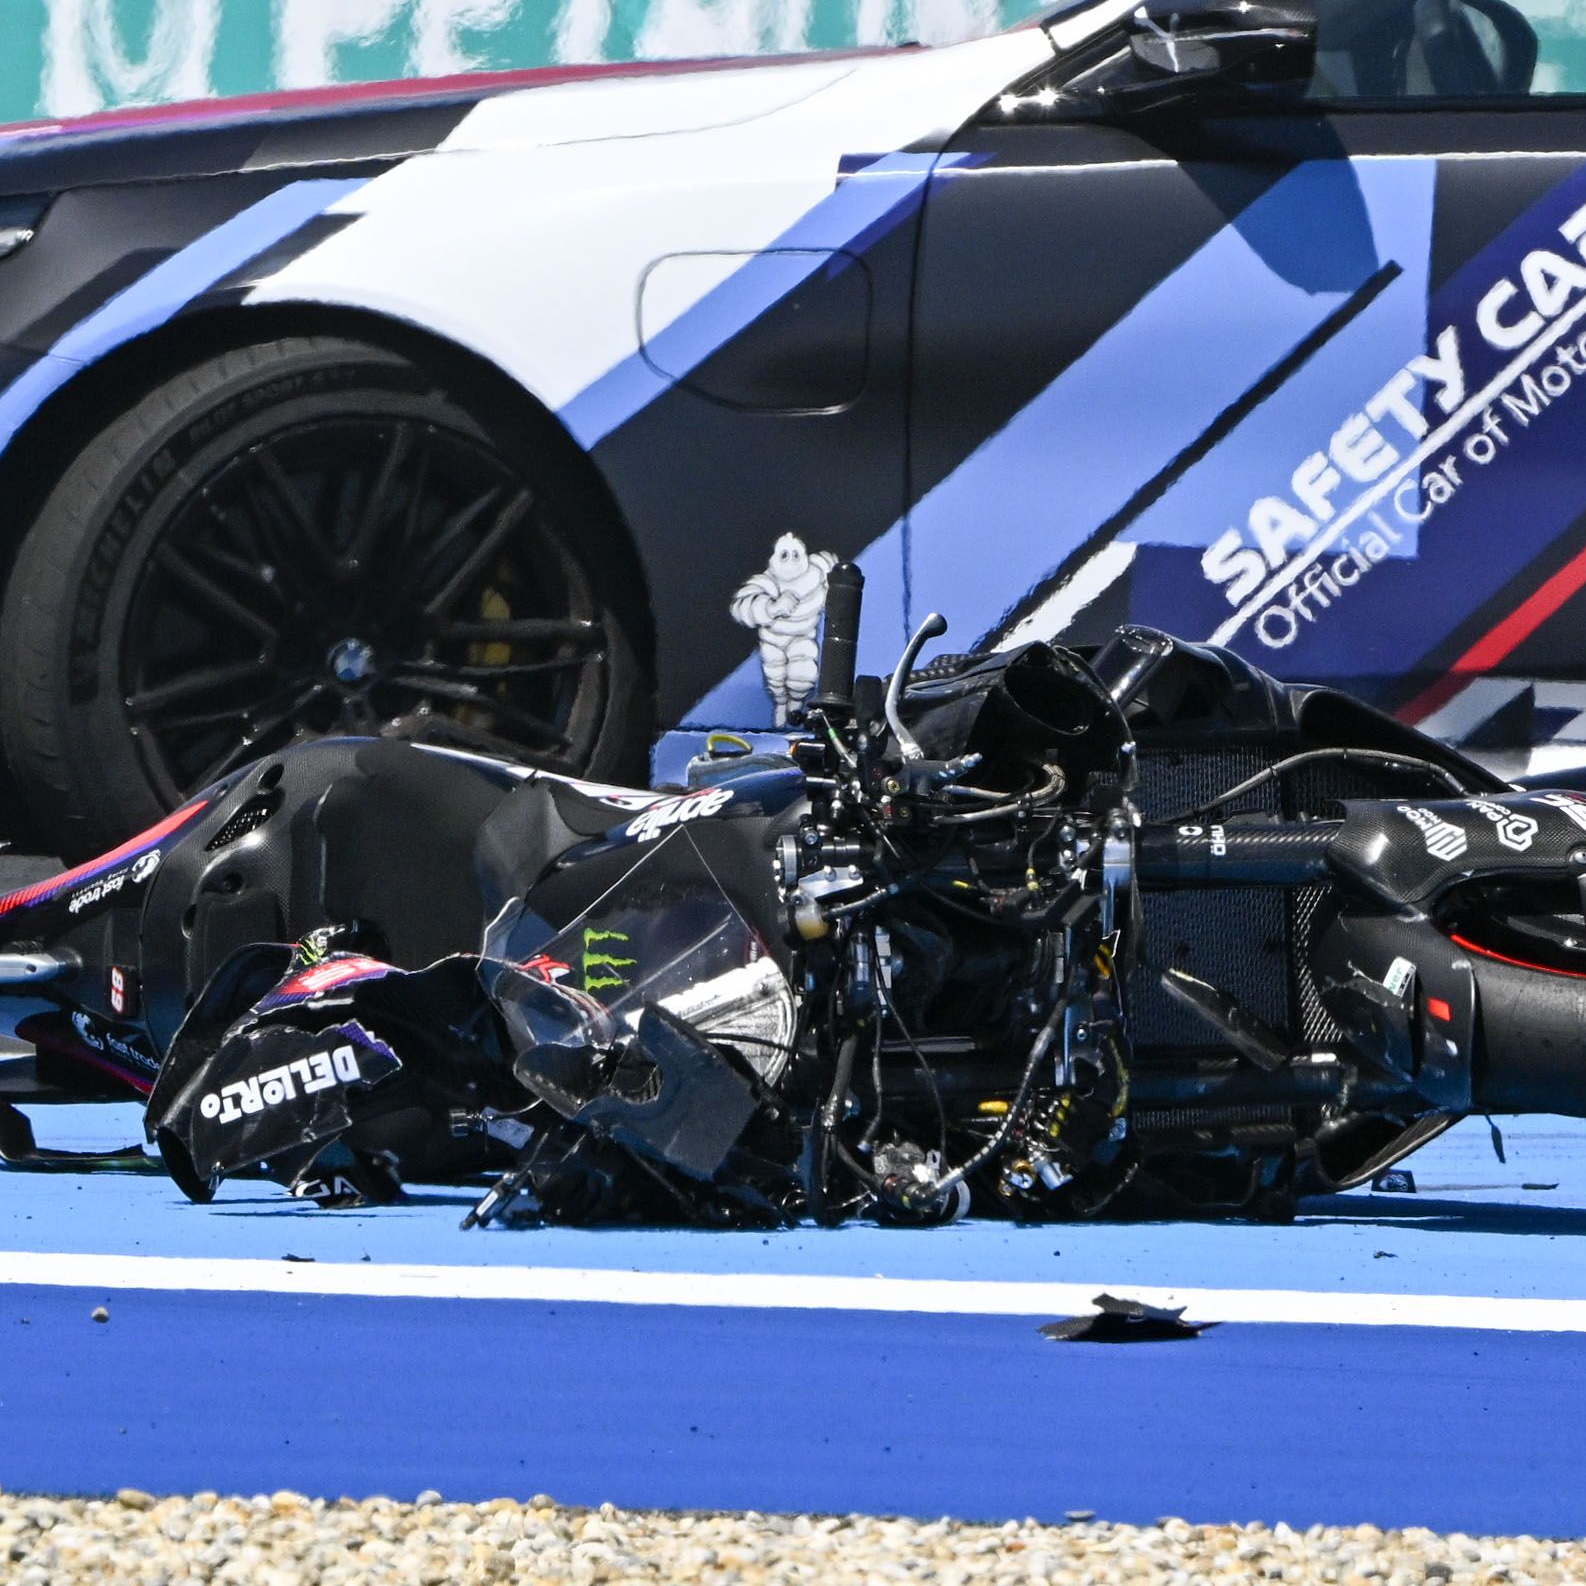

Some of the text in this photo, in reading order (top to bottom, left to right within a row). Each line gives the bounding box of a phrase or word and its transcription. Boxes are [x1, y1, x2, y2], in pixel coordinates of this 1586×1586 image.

[1200, 324, 1466, 608] SAFETY
[1253, 510, 1404, 650] Official
[1393, 454, 1465, 525] Car
[1464, 407, 1512, 466] of
